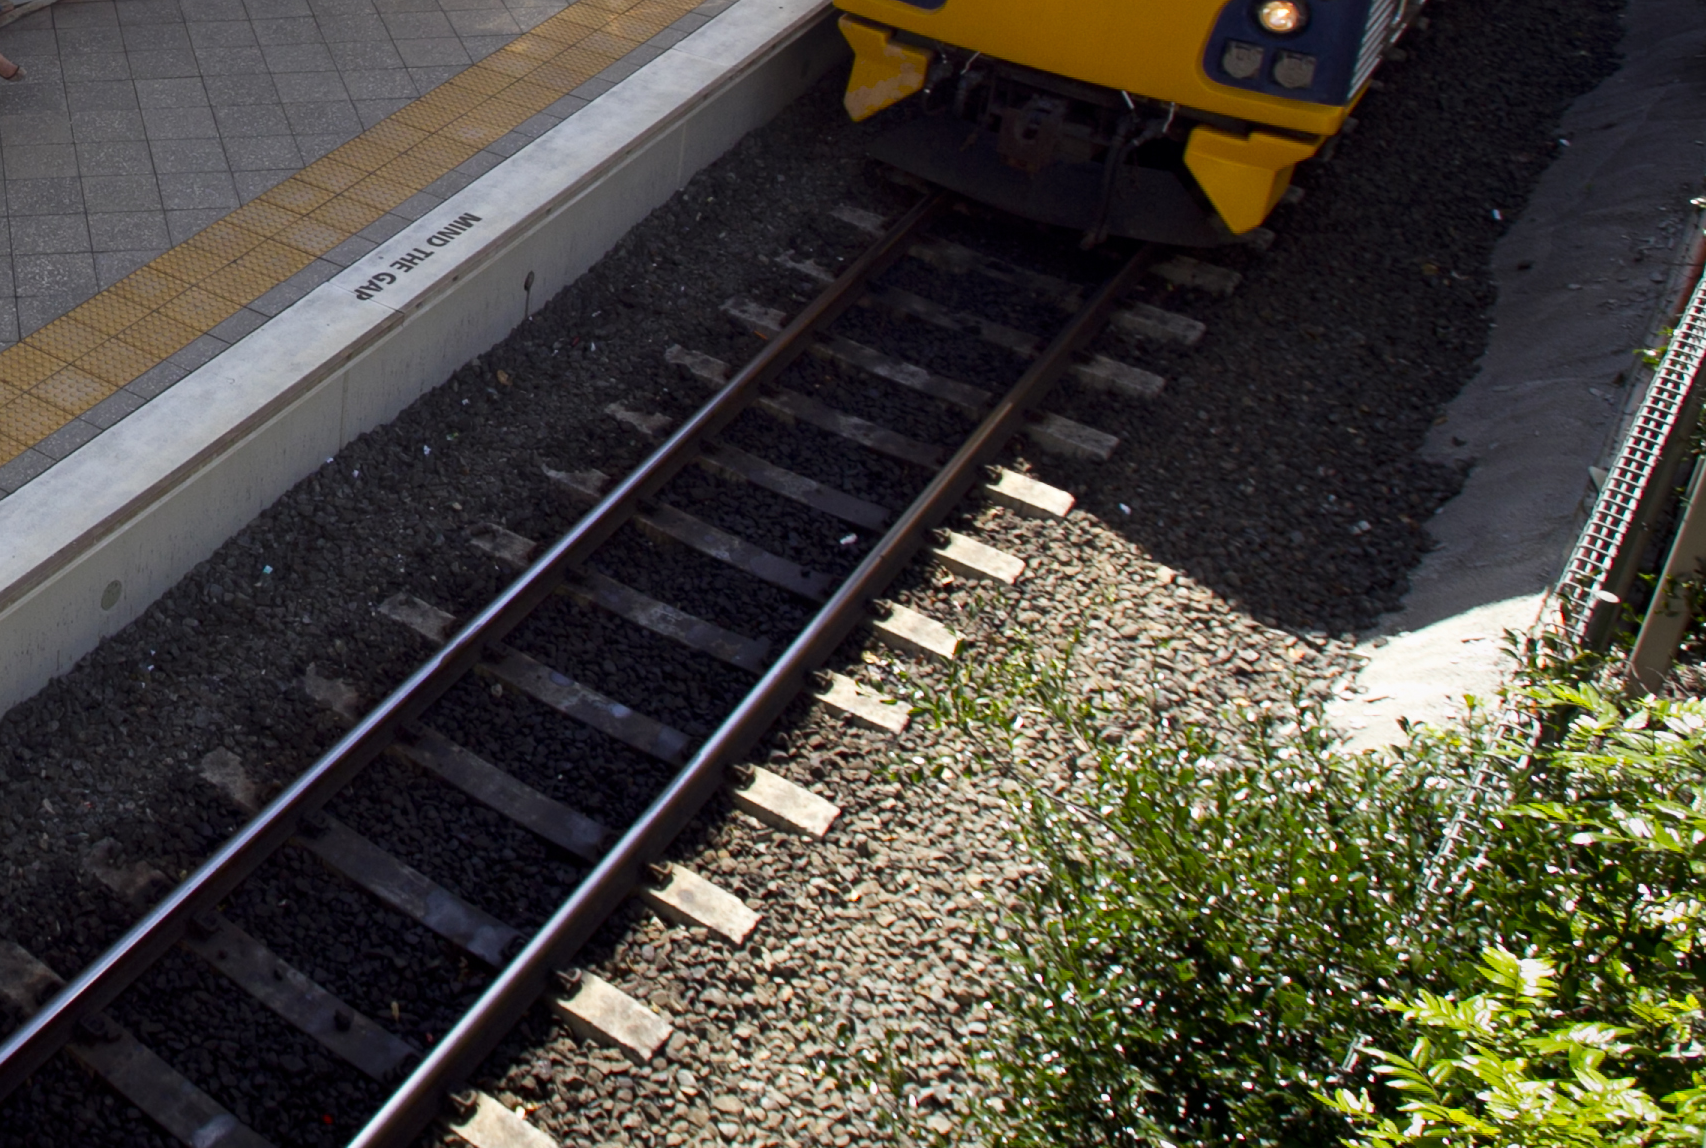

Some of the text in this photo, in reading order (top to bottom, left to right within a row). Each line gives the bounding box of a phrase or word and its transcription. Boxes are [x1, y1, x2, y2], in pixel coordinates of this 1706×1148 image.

[354, 212, 483, 301] MIND THE GAP
